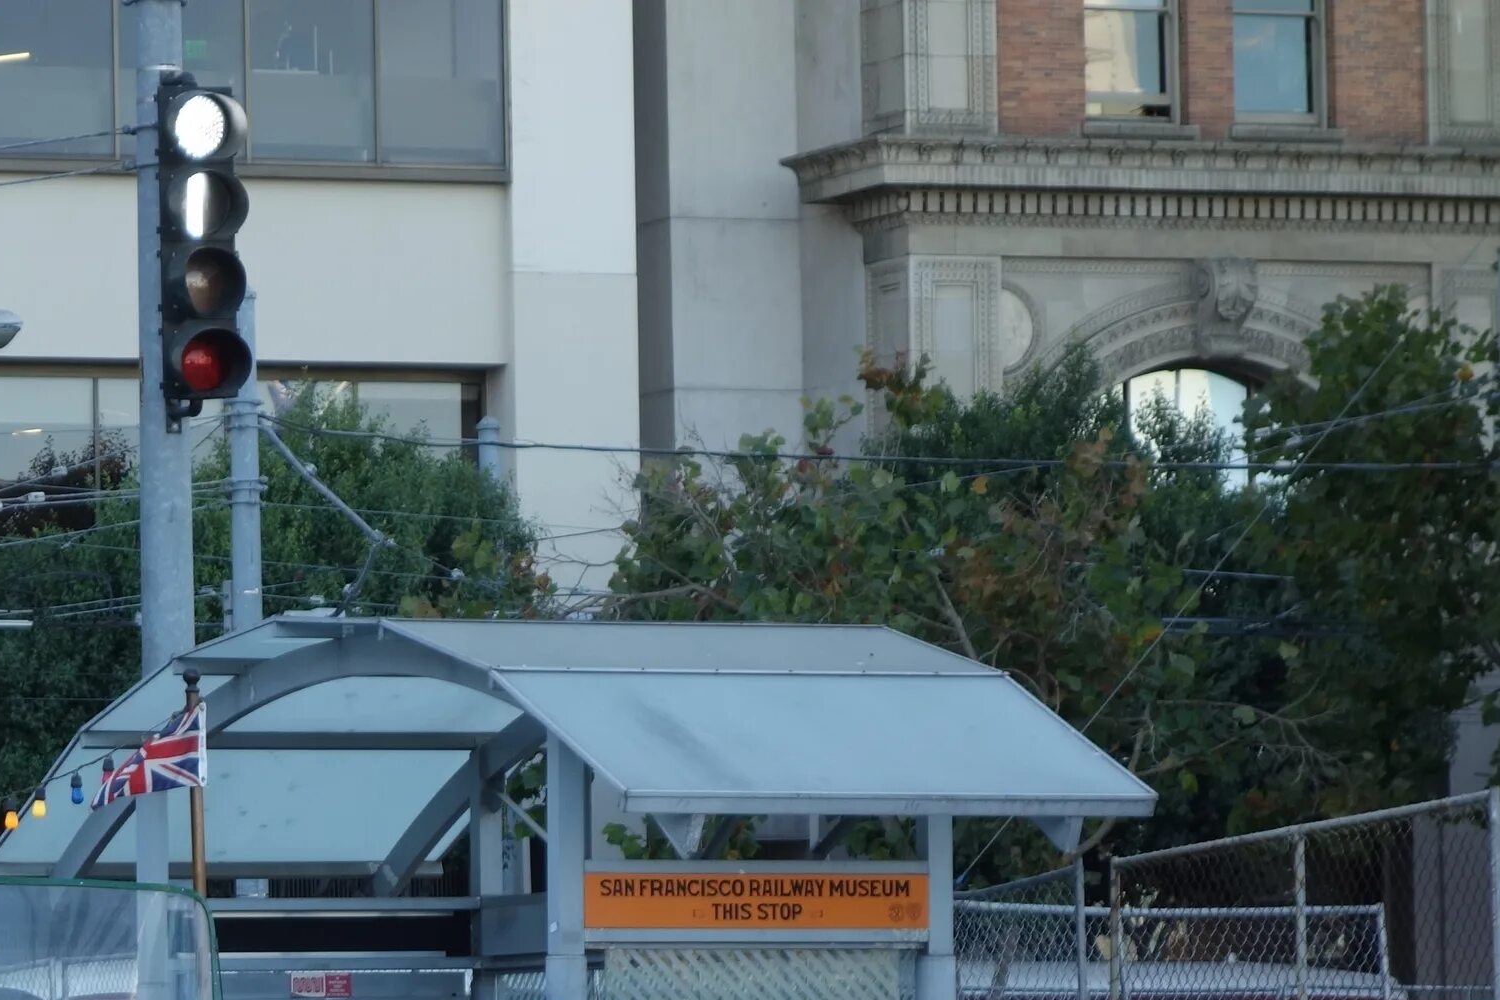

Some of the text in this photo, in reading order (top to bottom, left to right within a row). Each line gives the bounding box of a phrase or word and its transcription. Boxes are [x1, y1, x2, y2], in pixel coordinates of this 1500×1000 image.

[600, 878, 911, 897] SAN FRANCISCO RAILWAY MUSEUM
[711, 902, 803, 921] THIS STOP
